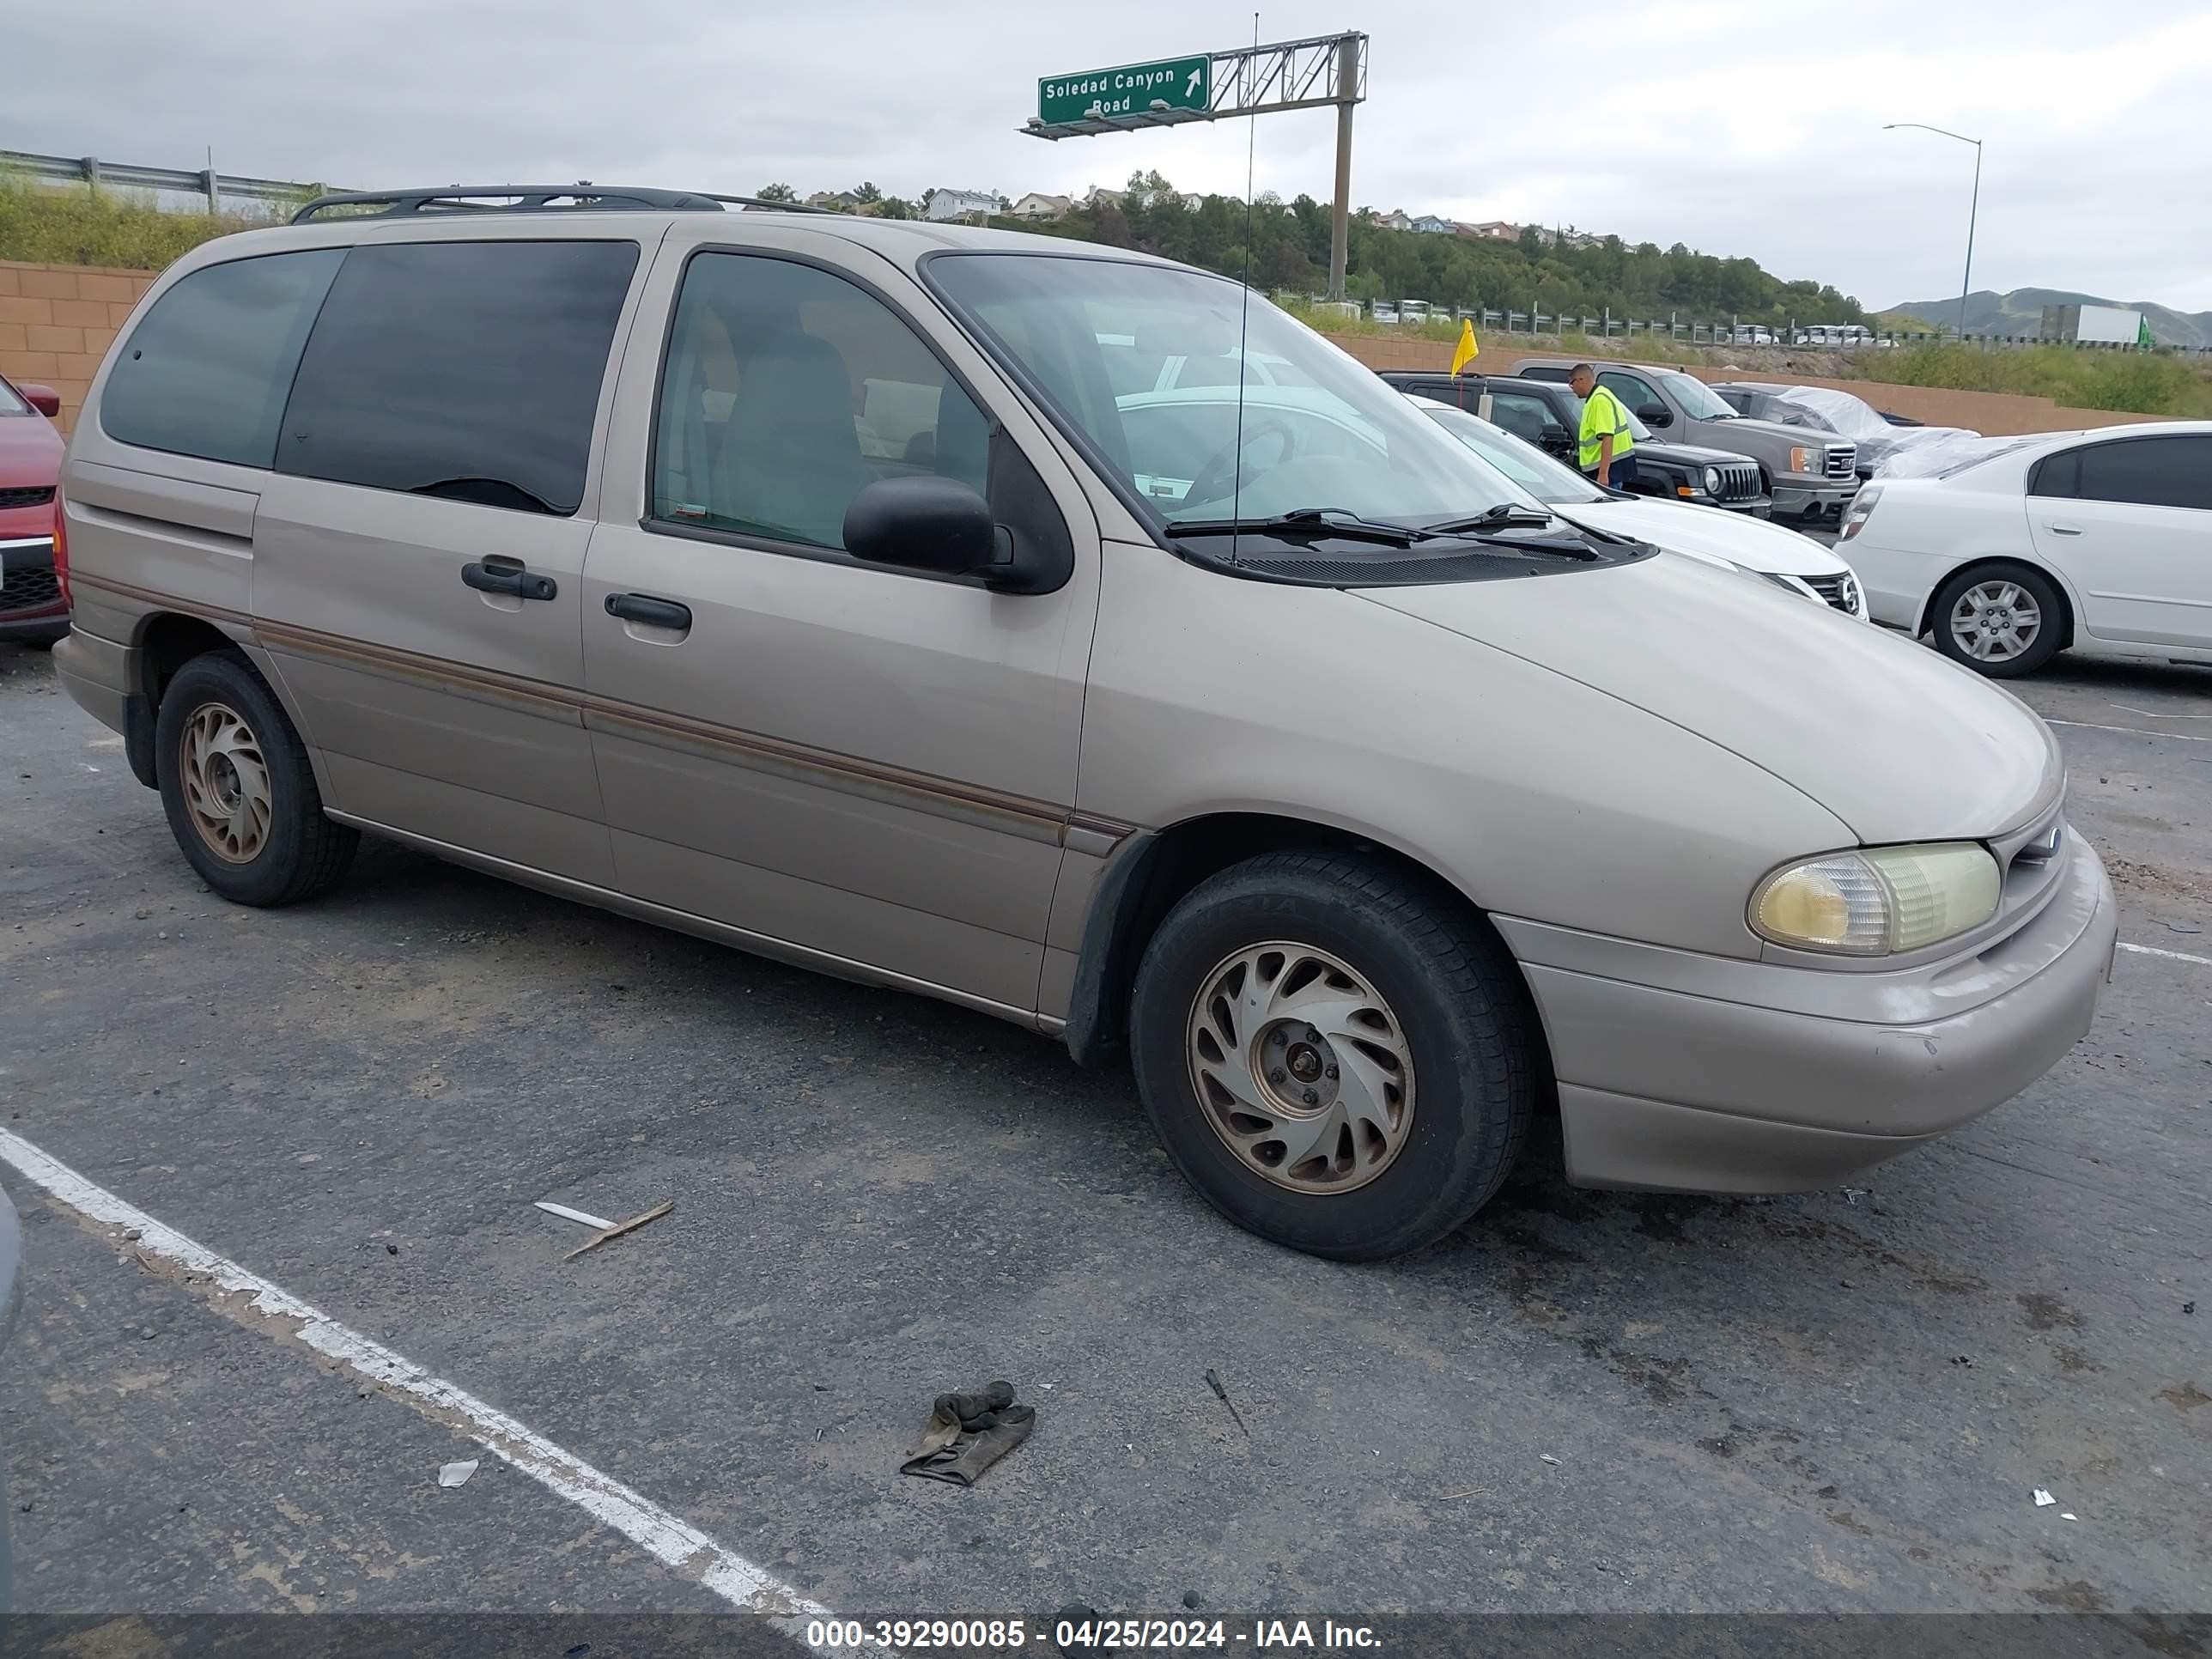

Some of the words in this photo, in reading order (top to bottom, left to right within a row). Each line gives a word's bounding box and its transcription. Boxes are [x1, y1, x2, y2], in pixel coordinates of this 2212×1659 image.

[1046, 76, 1108, 99] Soledad
[1115, 70, 1175, 91] Canyon
[1092, 95, 1131, 113] Road
